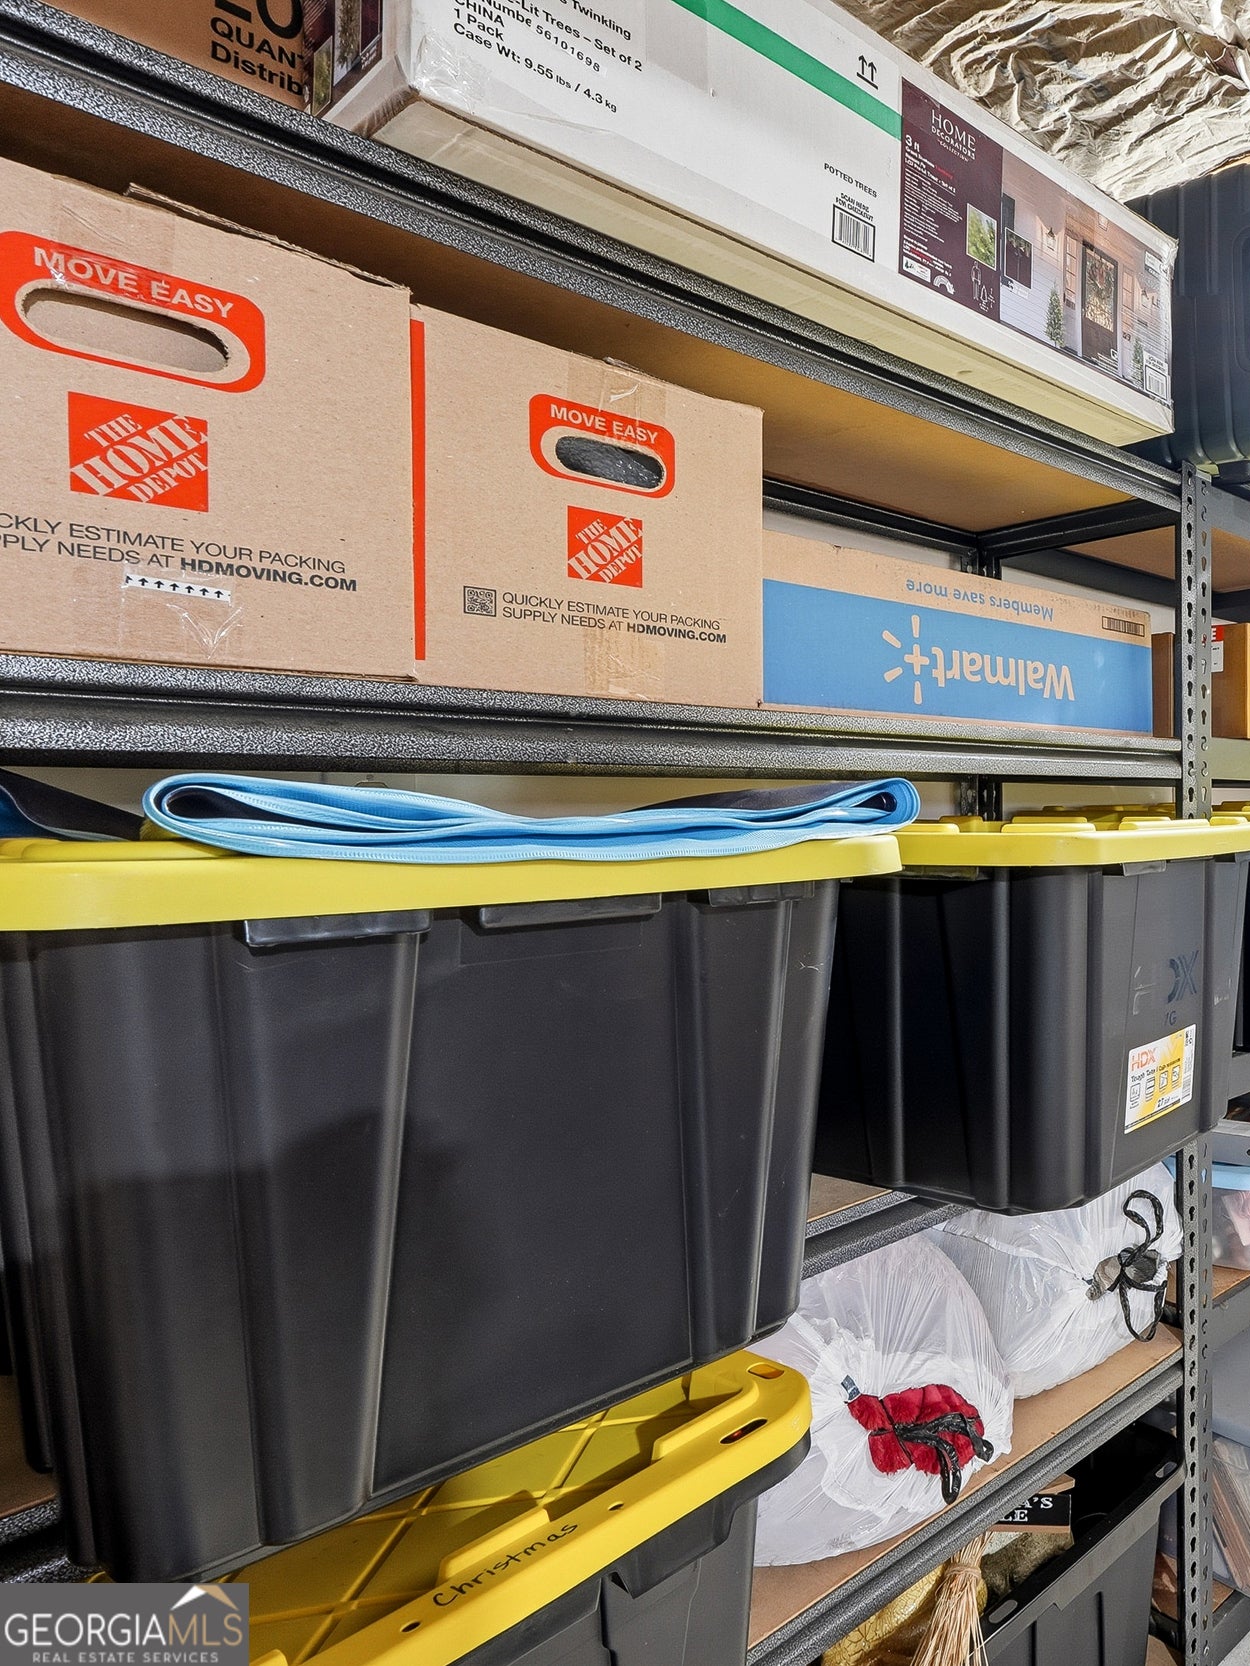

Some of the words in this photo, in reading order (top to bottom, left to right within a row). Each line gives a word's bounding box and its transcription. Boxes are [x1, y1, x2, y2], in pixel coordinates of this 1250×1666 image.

[453, 8, 461, 19] 1
[467, 13, 505, 42] Pack
[506, 0, 540, 17] -Lit
[542, 10, 580, 39] Trees
[594, 37, 617, 58] Set
[618, 51, 637, 66] of
[634, 60, 643, 72] 2
[571, 0, 633, 41] Twinkling
[454, 22, 493, 49] Case
[496, 42, 521, 64] Wt:
[524, 57, 554, 80] 9.55
[556, 74, 572, 89] lbs
[583, 87, 603, 104] 4.3
[604, 99, 618, 113] kg
[536, 24, 601, 73] 56101698
[905, 135, 913, 147] 3
[931, 109, 976, 152] HOME
[824, 163, 854, 184] POTTED
[854, 180, 877, 198] TREES
[34, 246, 139, 293] MOVE
[151, 279, 234, 319] EASY
[84, 413, 143, 448] THE
[549, 403, 607, 433] MOVE
[612, 420, 659, 445] EASY
[70, 414, 208, 497] HOME
[126, 452, 208, 503] DEPOT
[69, 523, 185, 552] ESTIMATE
[190, 539, 253, 562] YOUR
[258, 551, 346, 574] PACKING
[568, 517, 643, 580] HOME
[575, 518, 608, 545] THE
[0, 533, 50, 552] PLY
[58, 541, 141, 565] NEEDS
[147, 553, 175, 568] AT
[180, 556, 358, 592] HDMOVING.COM
[598, 544, 643, 584] DEPOT
[905, 578, 948, 599] more
[953, 585, 987, 605] save
[989, 594, 1054, 623] Members
[502, 592, 564, 610] QUICKLY
[567, 600, 630, 619] ESTIMATE
[632, 610, 668, 624] YOUR
[670, 614, 721, 631] PACKING
[502, 606, 558, 624] SUPPLY
[561, 614, 606, 630] NEEDS
[608, 620, 625, 632] AT
[626, 622, 728, 644] HDMOVING.COM
[1130, 1047, 1157, 1071] HDX
[432, 1523, 578, 1607] Christmas
